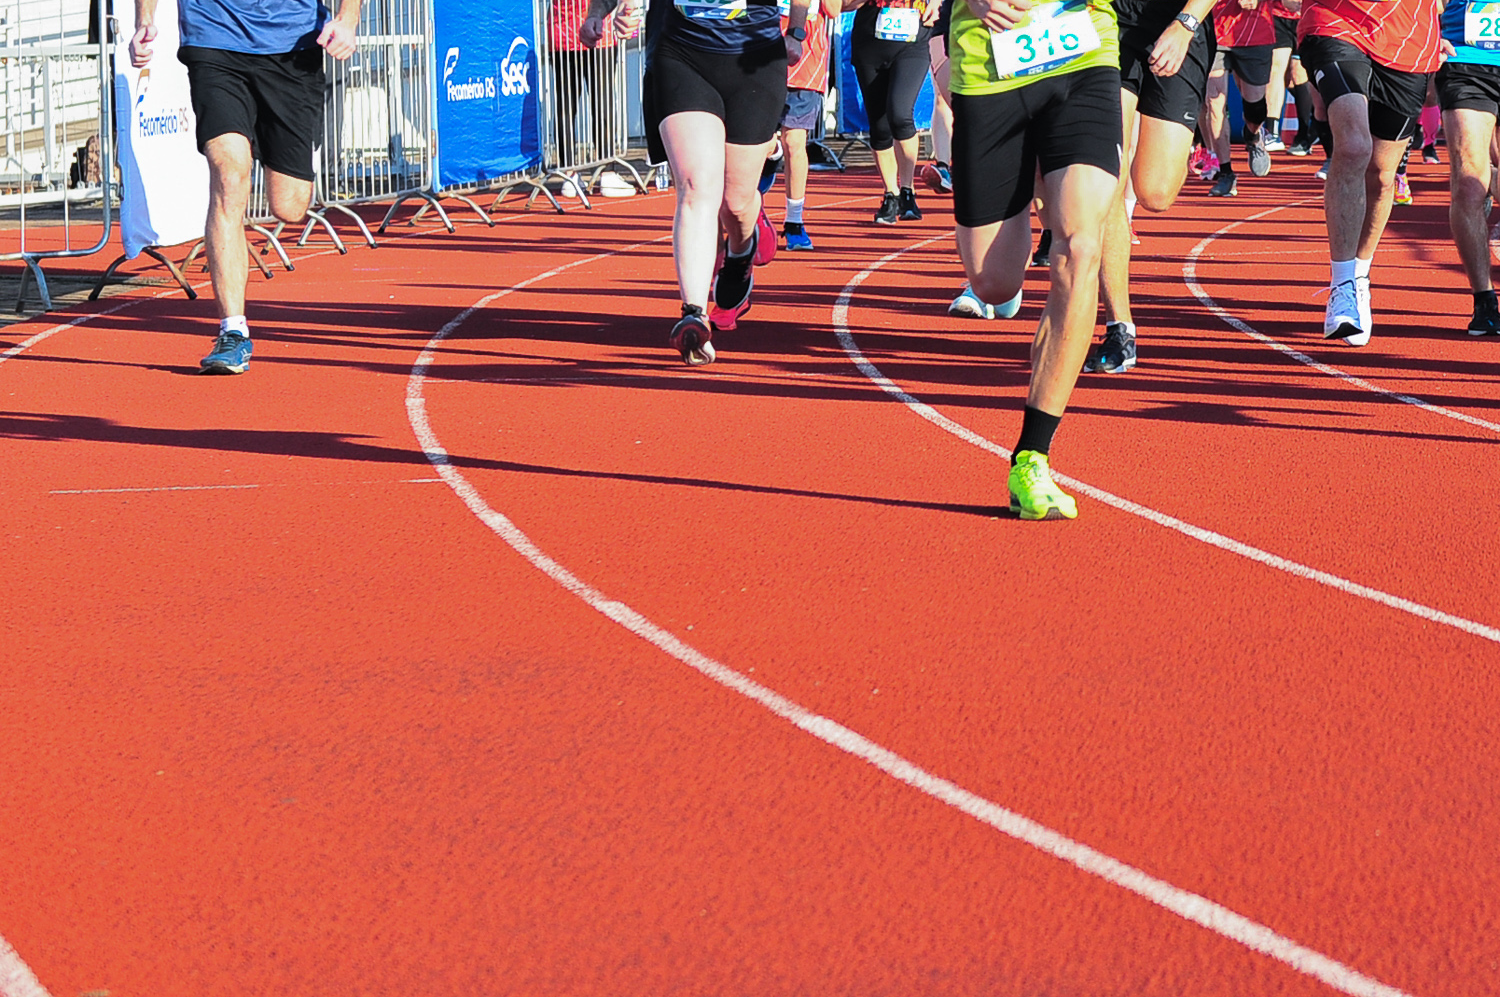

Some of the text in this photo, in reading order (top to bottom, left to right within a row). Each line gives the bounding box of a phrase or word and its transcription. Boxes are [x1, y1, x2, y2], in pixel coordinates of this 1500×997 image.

[447, 76, 496, 102] Fecomércio RS
[500, 57, 531, 97] Sesc
